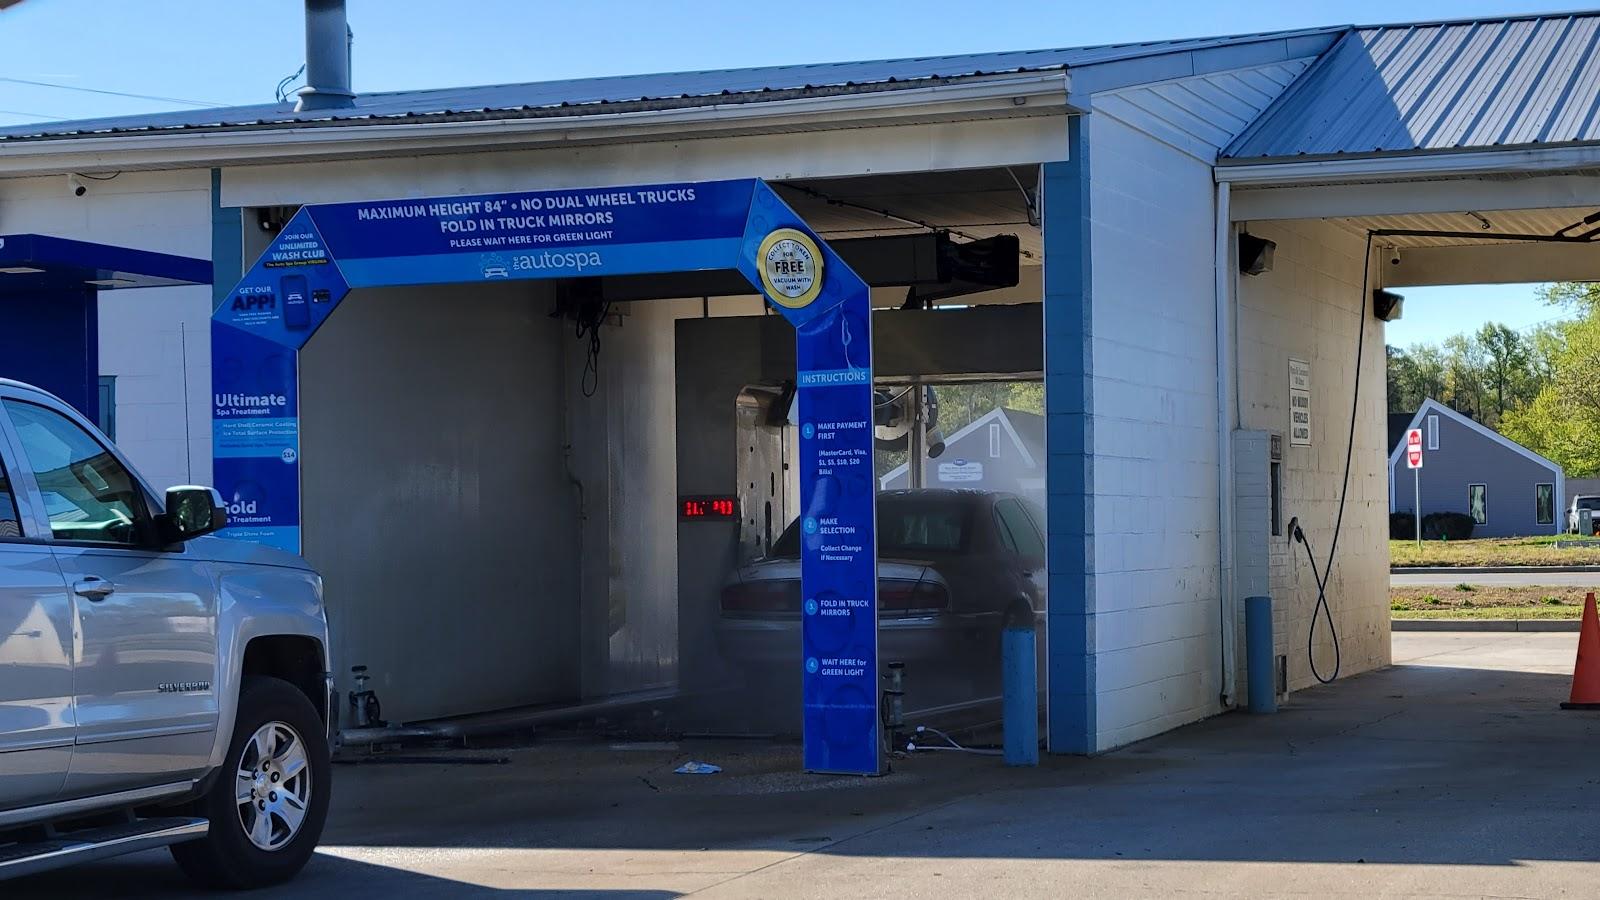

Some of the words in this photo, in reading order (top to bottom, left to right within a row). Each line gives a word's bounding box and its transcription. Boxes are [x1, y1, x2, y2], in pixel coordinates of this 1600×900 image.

[358, 205, 427, 220] MAXIMUM
[429, 202, 481, 216] HEIGHT
[520, 198, 543, 211] NO
[545, 196, 584, 209] DUAL
[585, 192, 636, 207] WHEEL
[637, 188, 696, 204] TRUCKS
[441, 220, 477, 233] FOLD
[480, 219, 495, 231] IN
[497, 216, 546, 229] TRUCK
[548, 211, 614, 226] MIRRORS
[450, 238, 482, 248] PLEASE
[483, 237, 507, 246] WAIT
[508, 235, 532, 244] HERE
[533, 234, 552, 243] FOR
[553, 232, 584, 242] GREEN
[585, 230, 613, 240] LIGHT
[279, 242, 318, 250] UNLIMITED
[768, 243, 789, 260] COLLECT
[792, 243, 810, 260] TOKEN
[272, 251, 300, 260] WASH
[302, 250, 325, 258] CLUB
[512, 256, 520, 270] the
[520, 251, 602, 272] autospa
[775, 261, 805, 273] FREE
[231, 294, 276, 311] APP!
[802, 371, 866, 384] INSTRUCTIONS
[216, 393, 286, 407] Ultimate
[216, 408, 230, 416] Spa
[837, 421, 867, 429] PAYMENT
[818, 432, 835, 440] FIRST
[826, 554, 853, 562] Necessary
[857, 658, 867, 666] for
